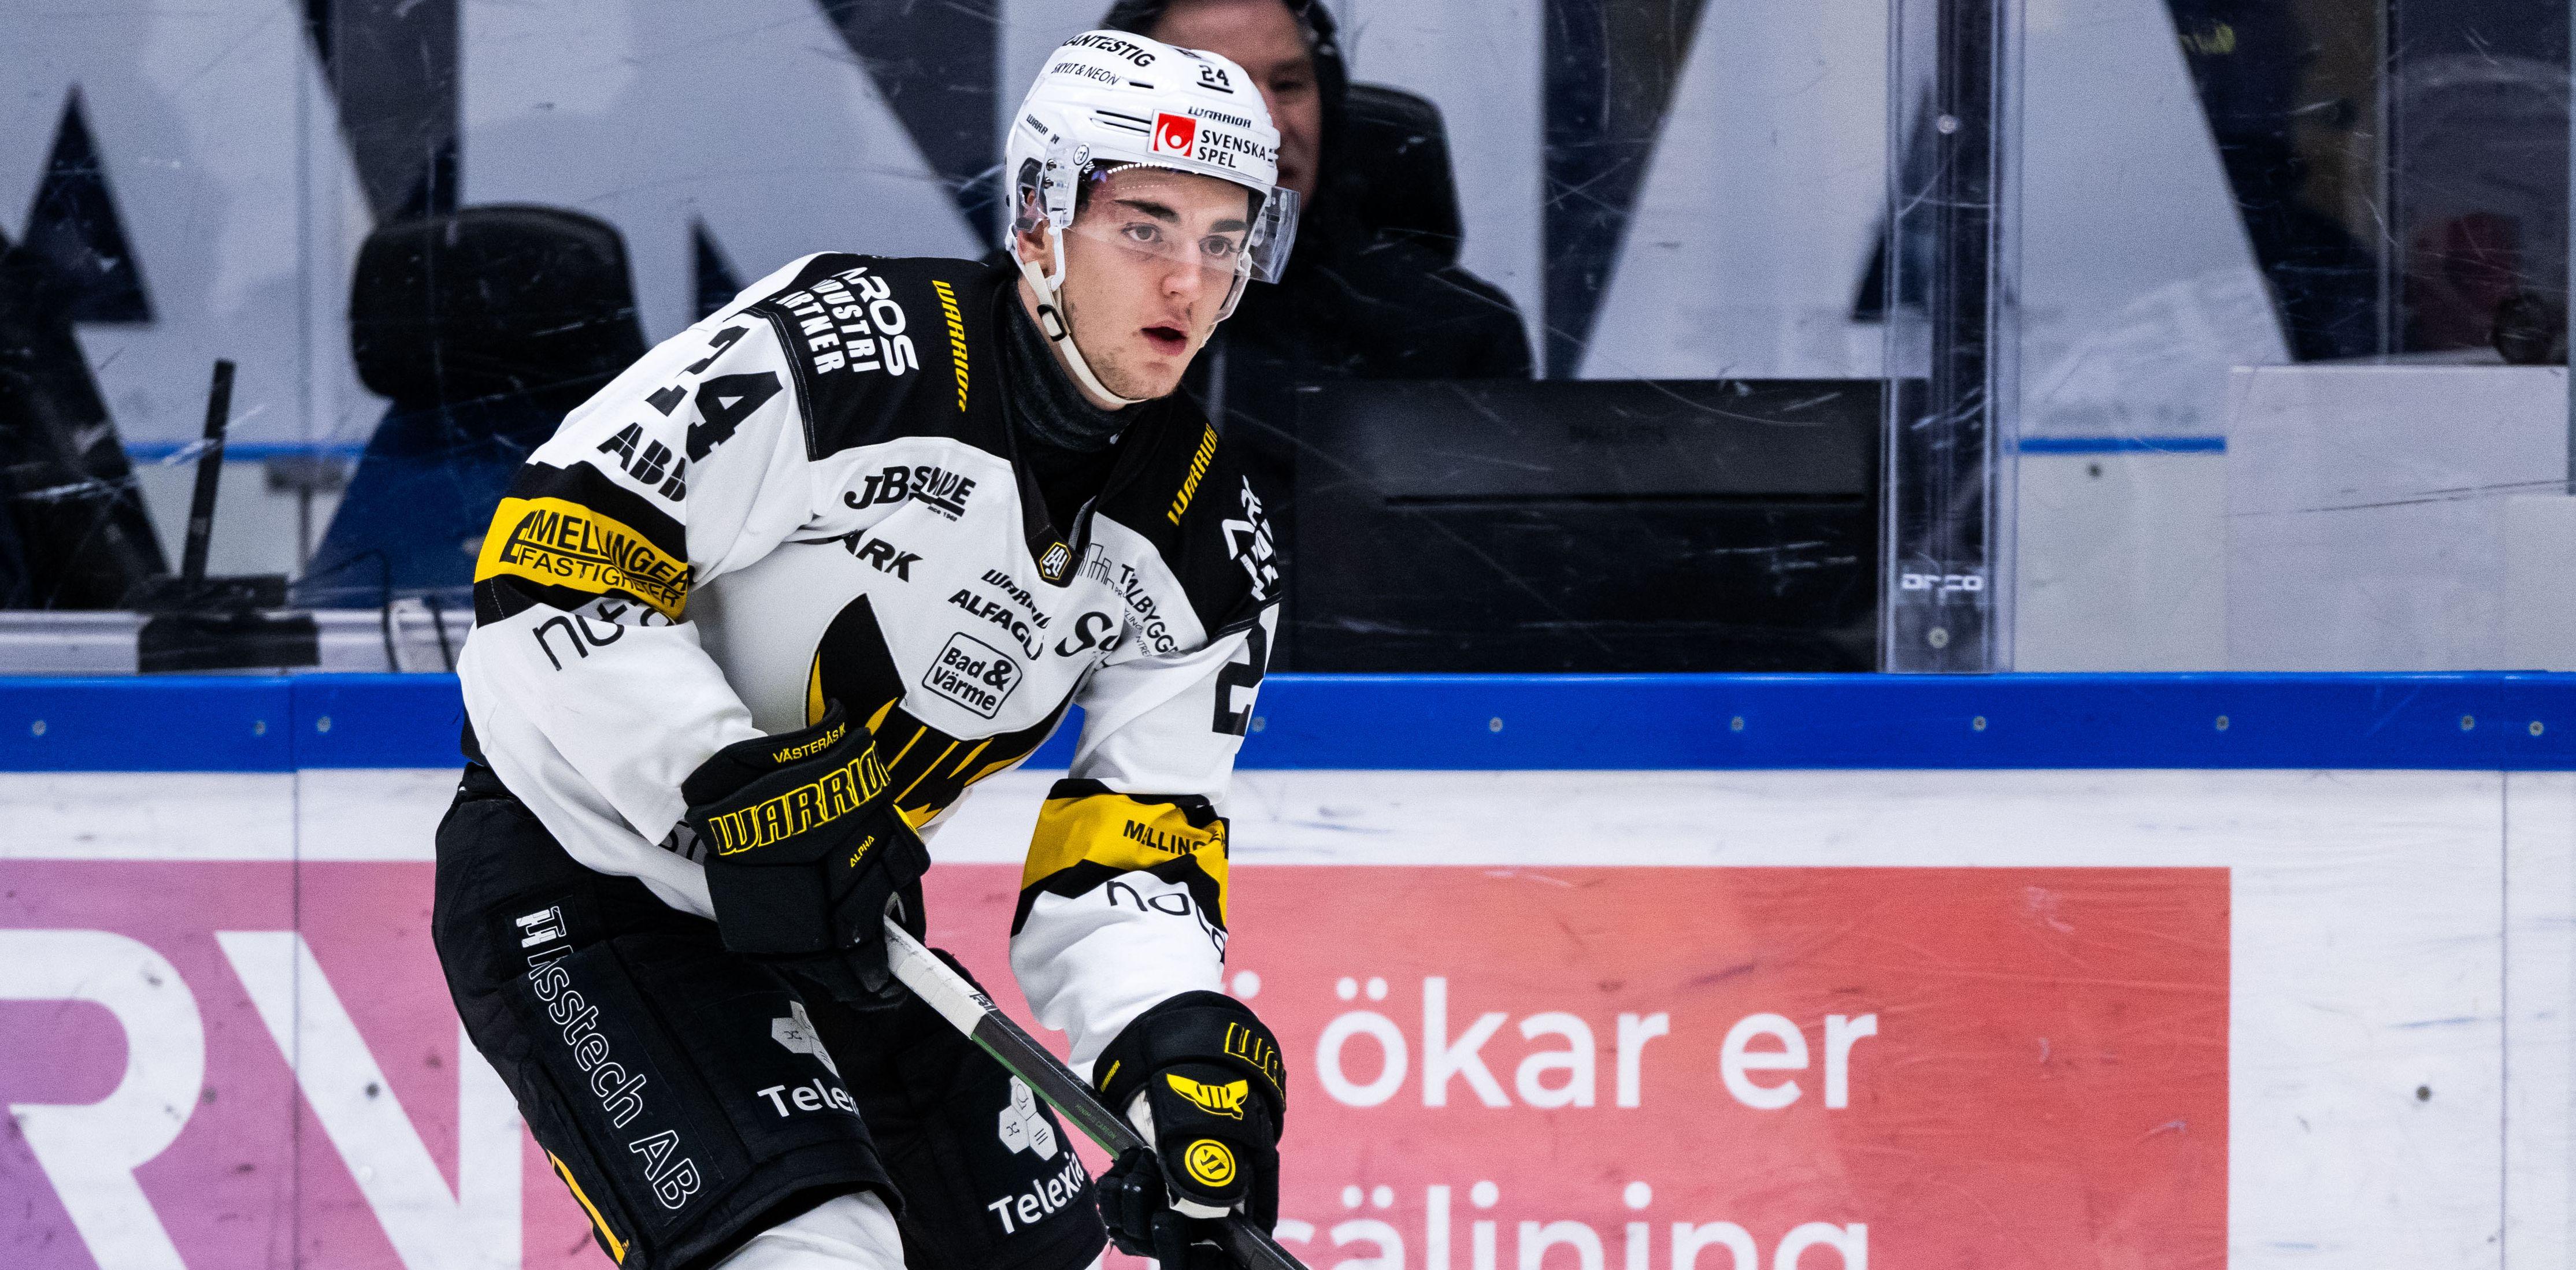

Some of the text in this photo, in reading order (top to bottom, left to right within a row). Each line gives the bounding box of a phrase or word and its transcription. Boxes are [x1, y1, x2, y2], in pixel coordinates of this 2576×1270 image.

[1076, 65, 1086, 75] &
[1084, 66, 1121, 85] NEON
[1199, 65, 1229, 86] 24
[1188, 106, 1252, 128] WARRIOR
[1198, 146, 1237, 168] SPEL
[1201, 129, 1266, 161] SVENSKA
[942, 647, 1013, 692] Bad &
[932, 666, 997, 711] Värme
[773, 730, 839, 763] VÄSTERÅS
[850, 835, 875, 867] ALPHA
[1315, 975, 1670, 1109] ökar
[1719, 1011, 1878, 1109] er
[757, 1078, 861, 1119] Tele
[629, 1129, 701, 1210] AB
[988, 1151, 1084, 1234] Telexia
